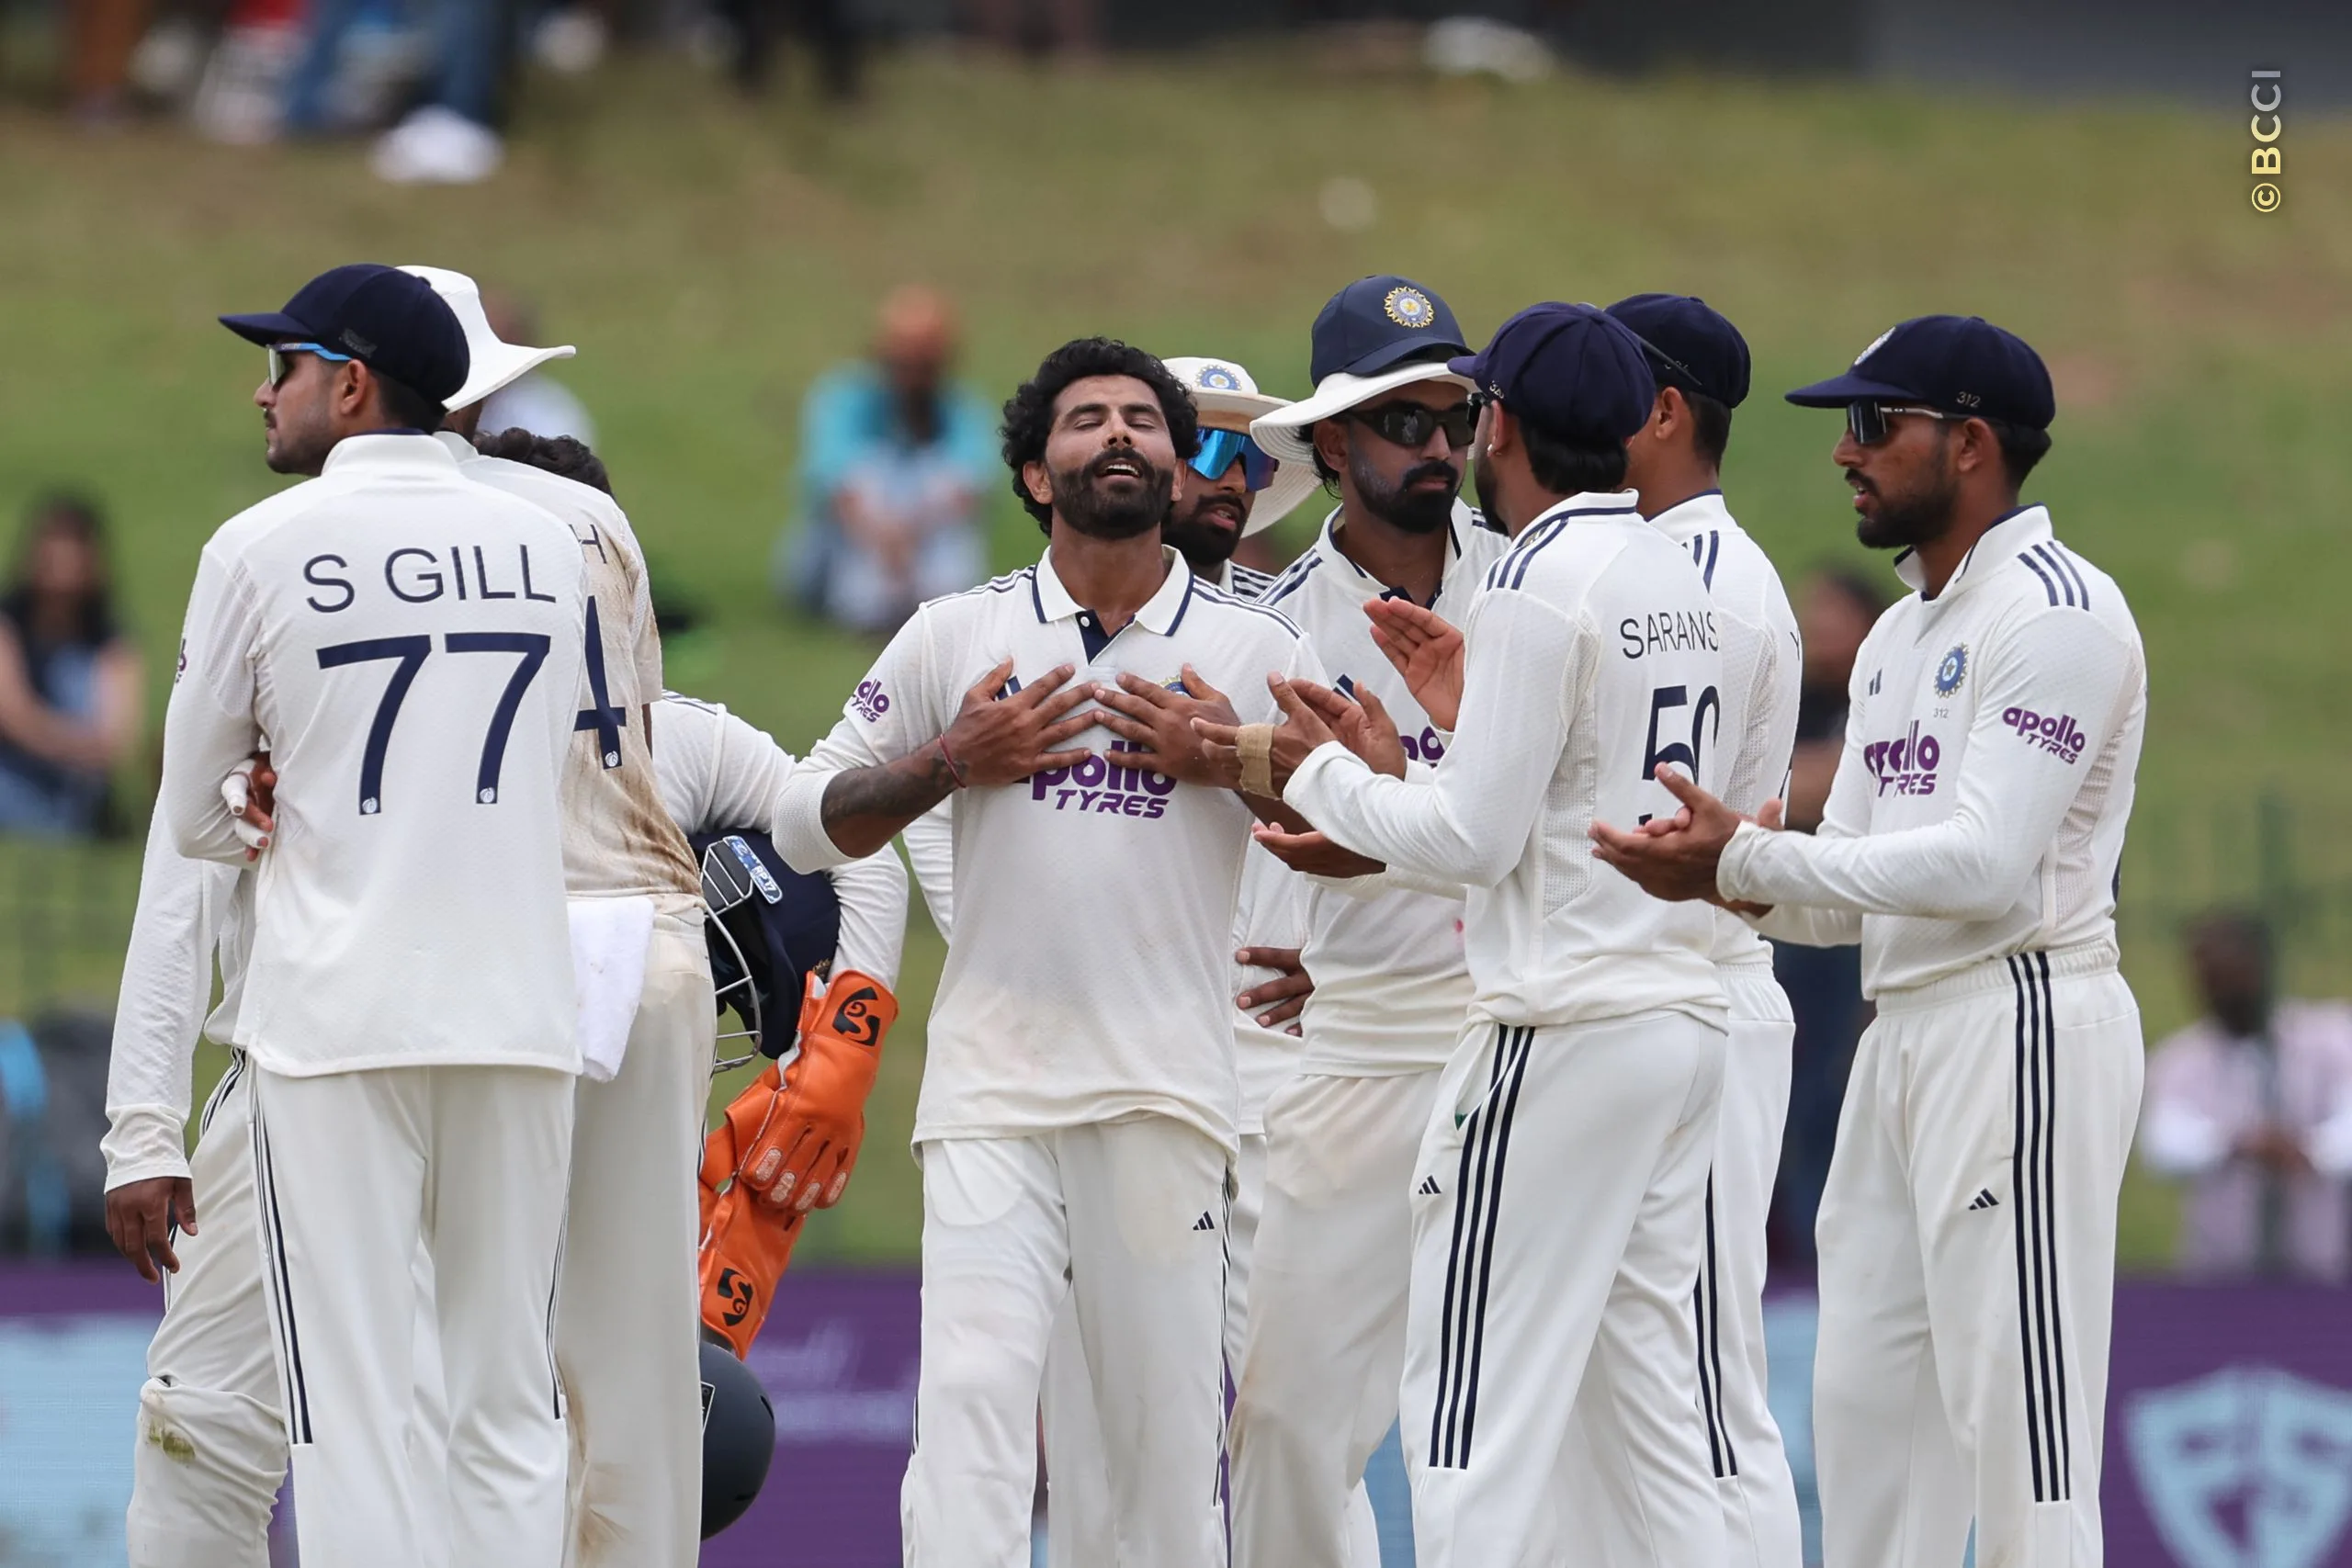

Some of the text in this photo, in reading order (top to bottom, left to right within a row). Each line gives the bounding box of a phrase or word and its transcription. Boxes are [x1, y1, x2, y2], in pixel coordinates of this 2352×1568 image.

[1956, 391, 1981, 408] 312
[303, 544, 557, 614] S GILL
[316, 632, 551, 816] 77
[2002, 707, 2086, 753] apollo
[2026, 733, 2078, 765] TYRES
[1013, 739, 1178, 801] pollo
[1878, 773, 1938, 798] TRES
[1056, 789, 1170, 819] TYRES
